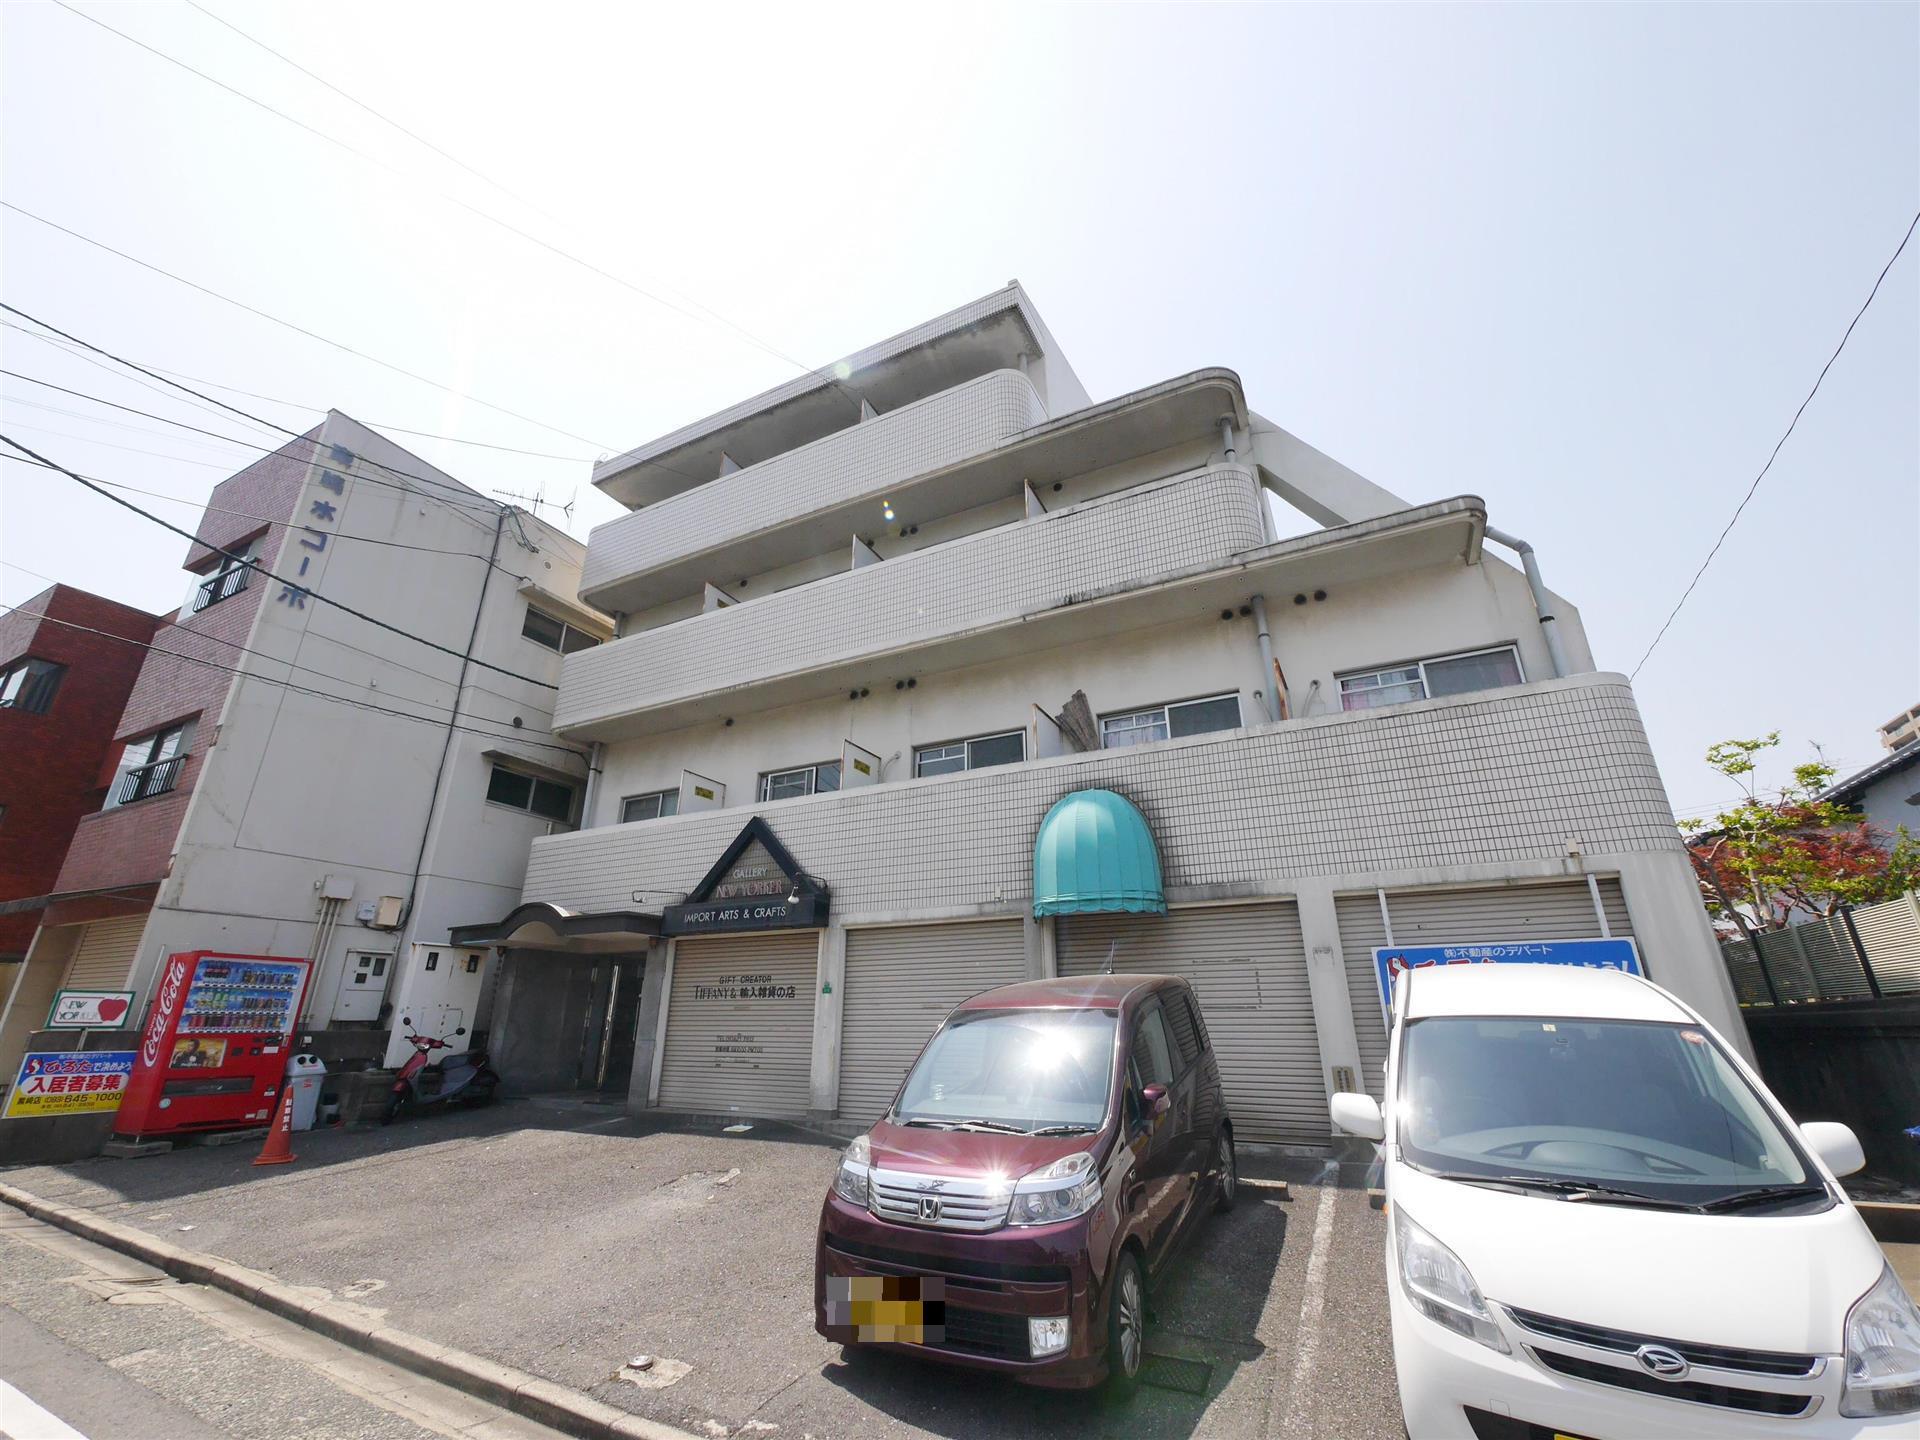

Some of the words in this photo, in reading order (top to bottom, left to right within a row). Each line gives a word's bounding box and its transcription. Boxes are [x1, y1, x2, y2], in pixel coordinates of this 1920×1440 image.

[732, 866, 769, 879] GALLERY
[716, 884, 738, 898] NEW
[741, 880, 782, 897] YORKER
[684, 911, 716, 923] IMPORT
[718, 909, 739, 920] ARTS
[743, 909, 750, 919] &
[754, 906, 786, 918] CRAFTS
[719, 975, 736, 985] GIFT
[740, 975, 773, 984] CREATOR
[740, 985, 796, 999] 輸入雑貨の店
[143, 956, 185, 1067] Coca-Cola
[28, 1074, 122, 1094] 入居者募集
